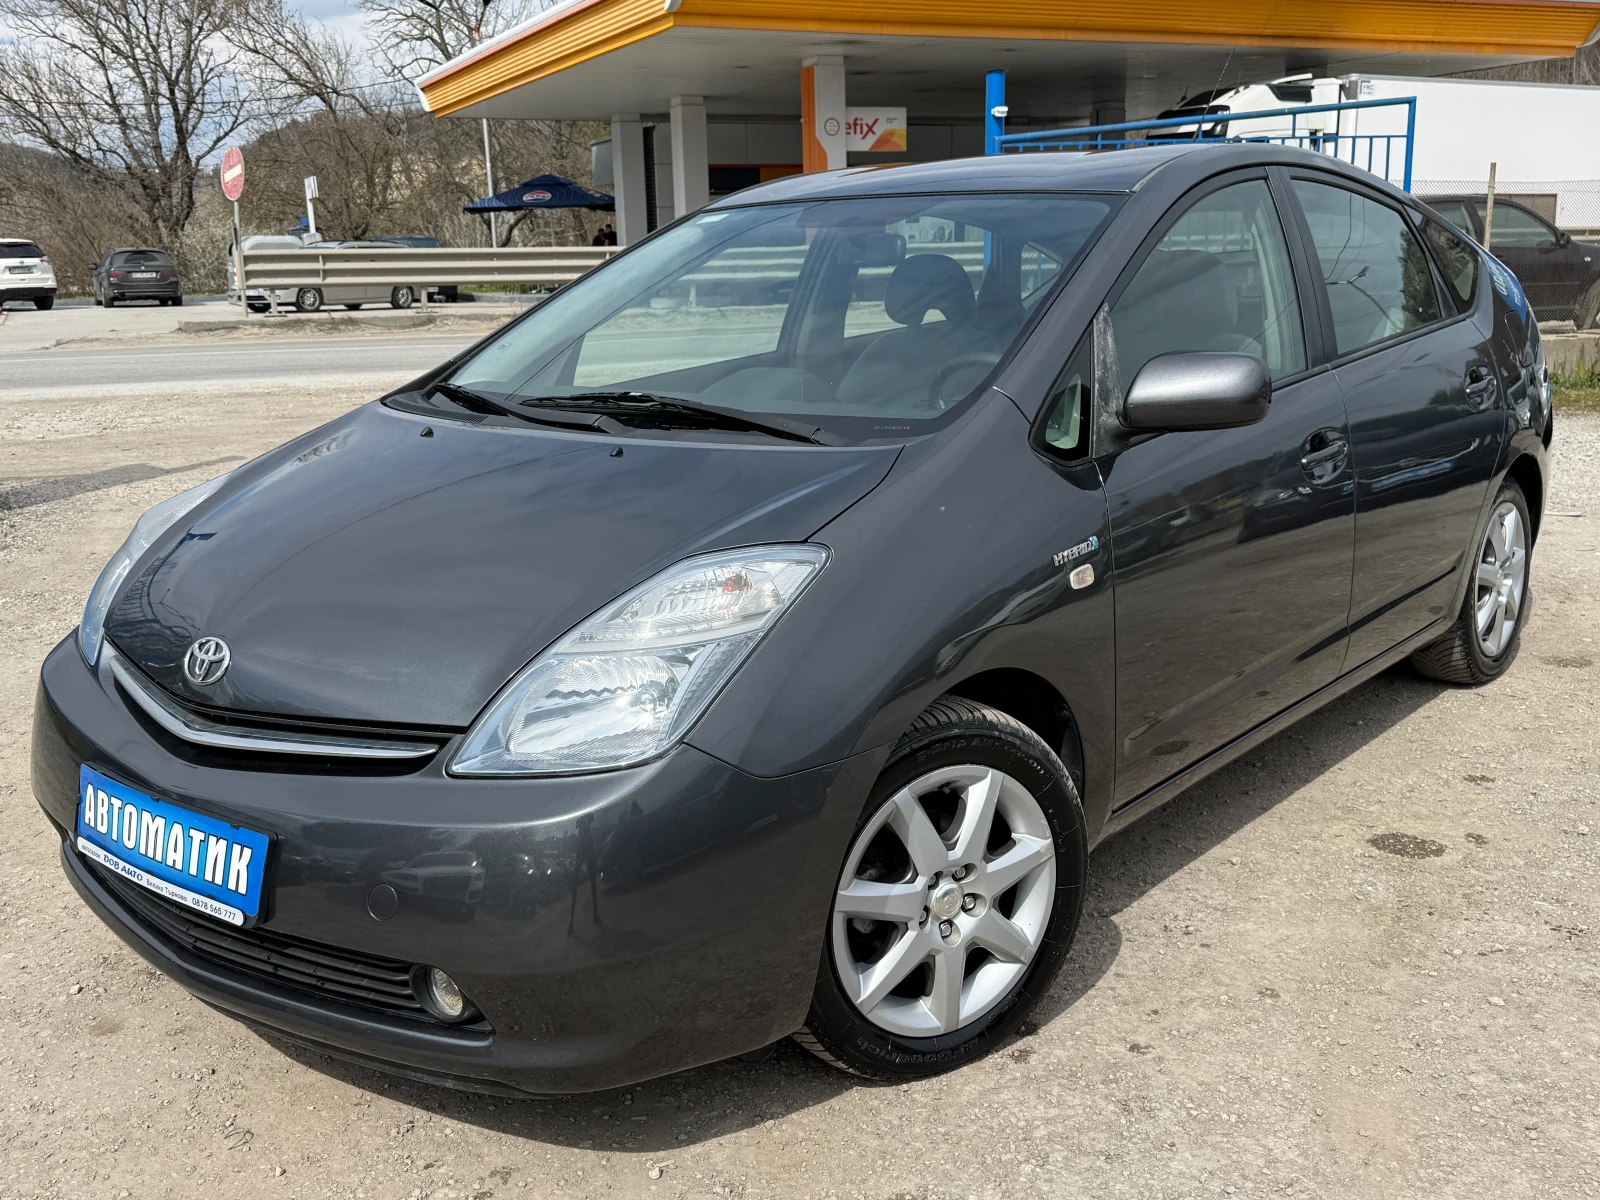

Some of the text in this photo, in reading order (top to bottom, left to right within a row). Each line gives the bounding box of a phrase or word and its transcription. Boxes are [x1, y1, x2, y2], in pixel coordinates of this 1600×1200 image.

[1053, 540, 1093, 567] HYBRID
[84, 783, 253, 896] АВТОМАТИК
[192, 897, 208, 910] 0878
[209, 904, 222, 916] 565
[223, 910, 236, 921] 777
